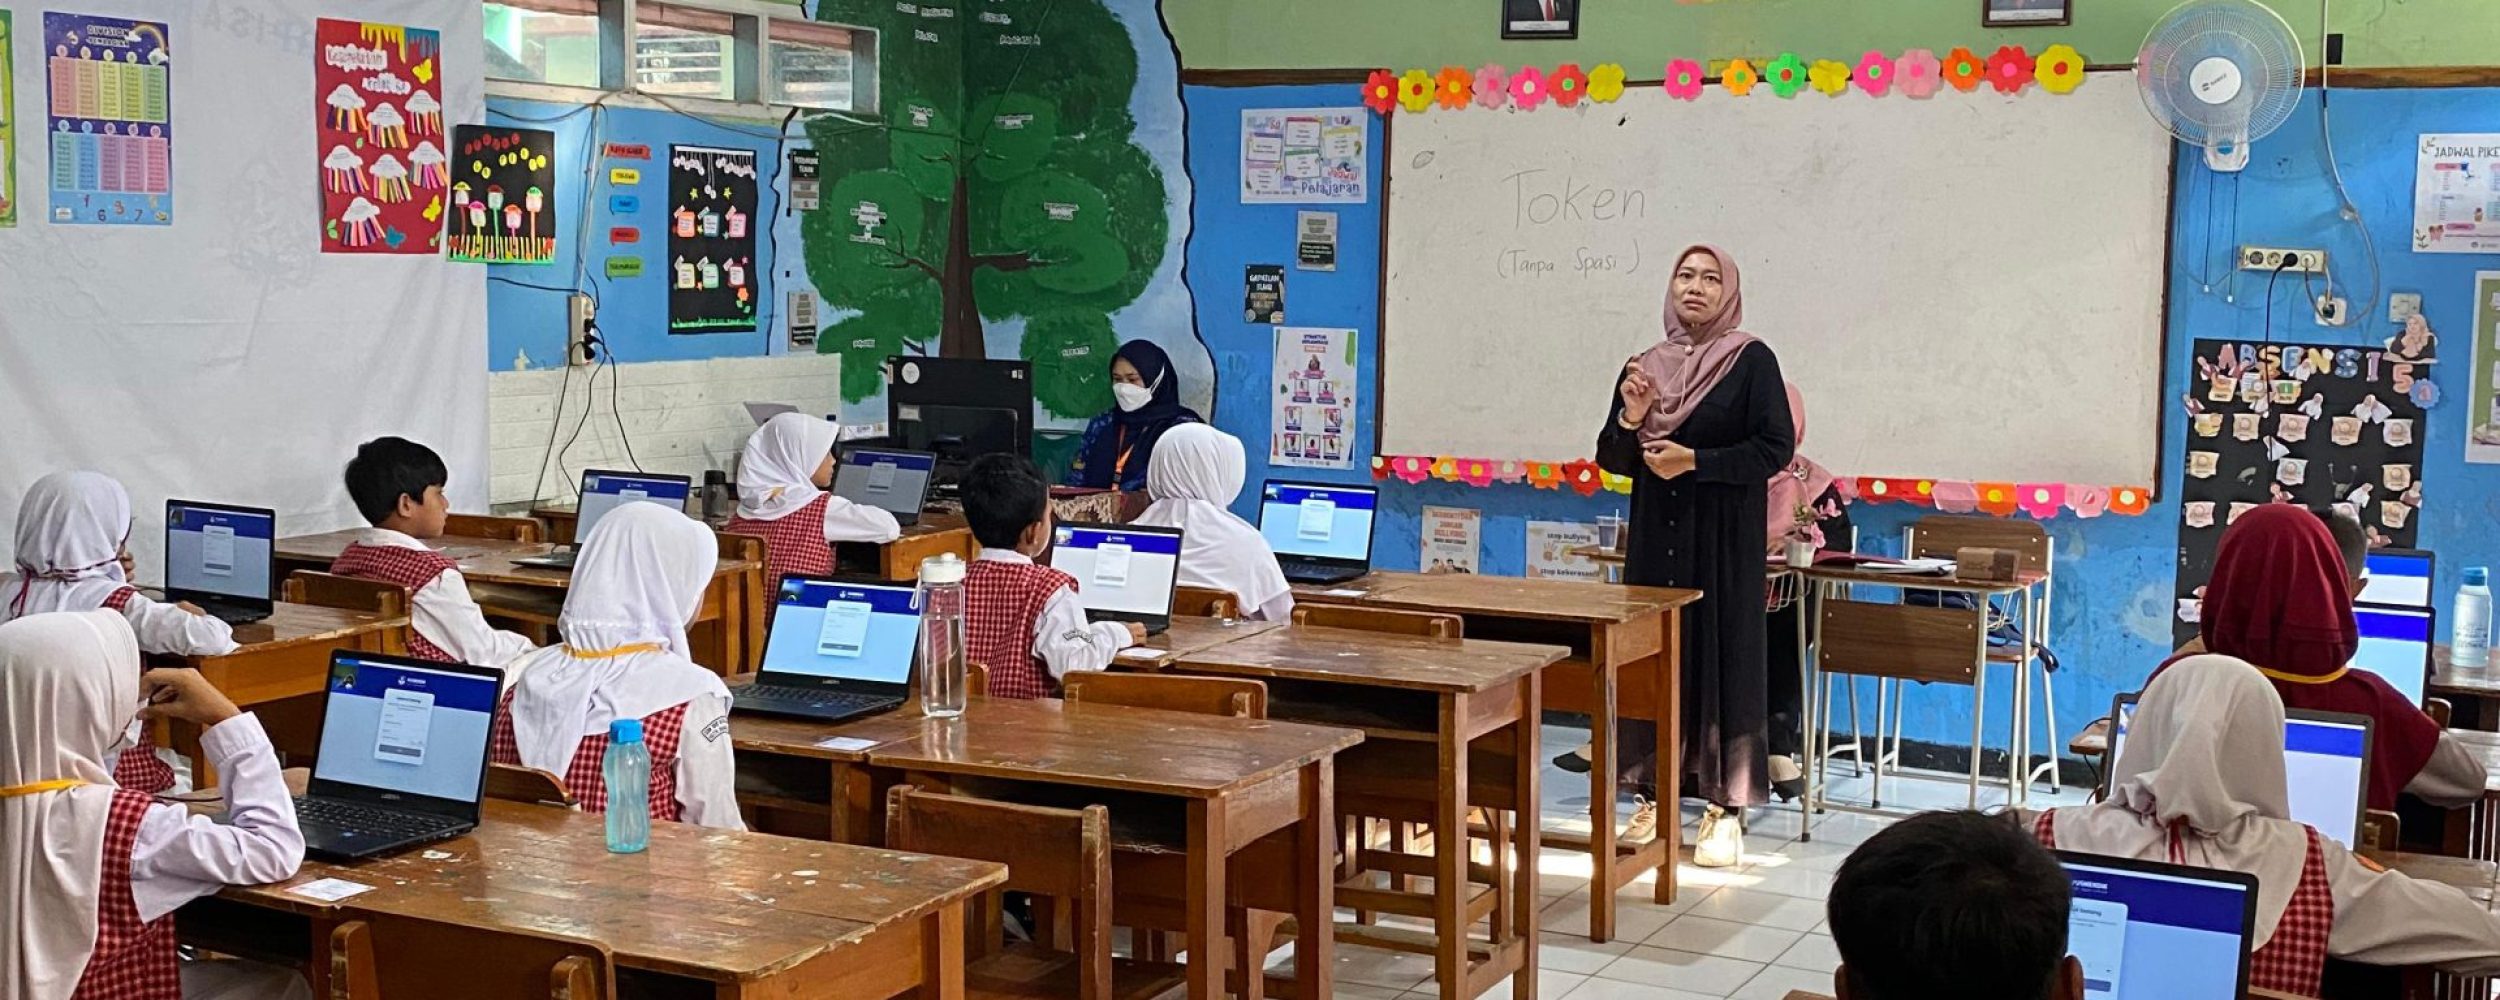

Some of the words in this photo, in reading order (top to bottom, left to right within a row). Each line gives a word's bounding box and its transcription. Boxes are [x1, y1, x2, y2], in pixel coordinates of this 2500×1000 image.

[86, 25, 130, 37] DIVISION
[2433, 146, 2474, 158] JADWAL
[1301, 180, 1360, 196] Pelajaran
[1501, 168, 1645, 231] Token
[1497, 248, 1555, 279] (Tanpa
[2217, 343, 2384, 383] ABSENSI
